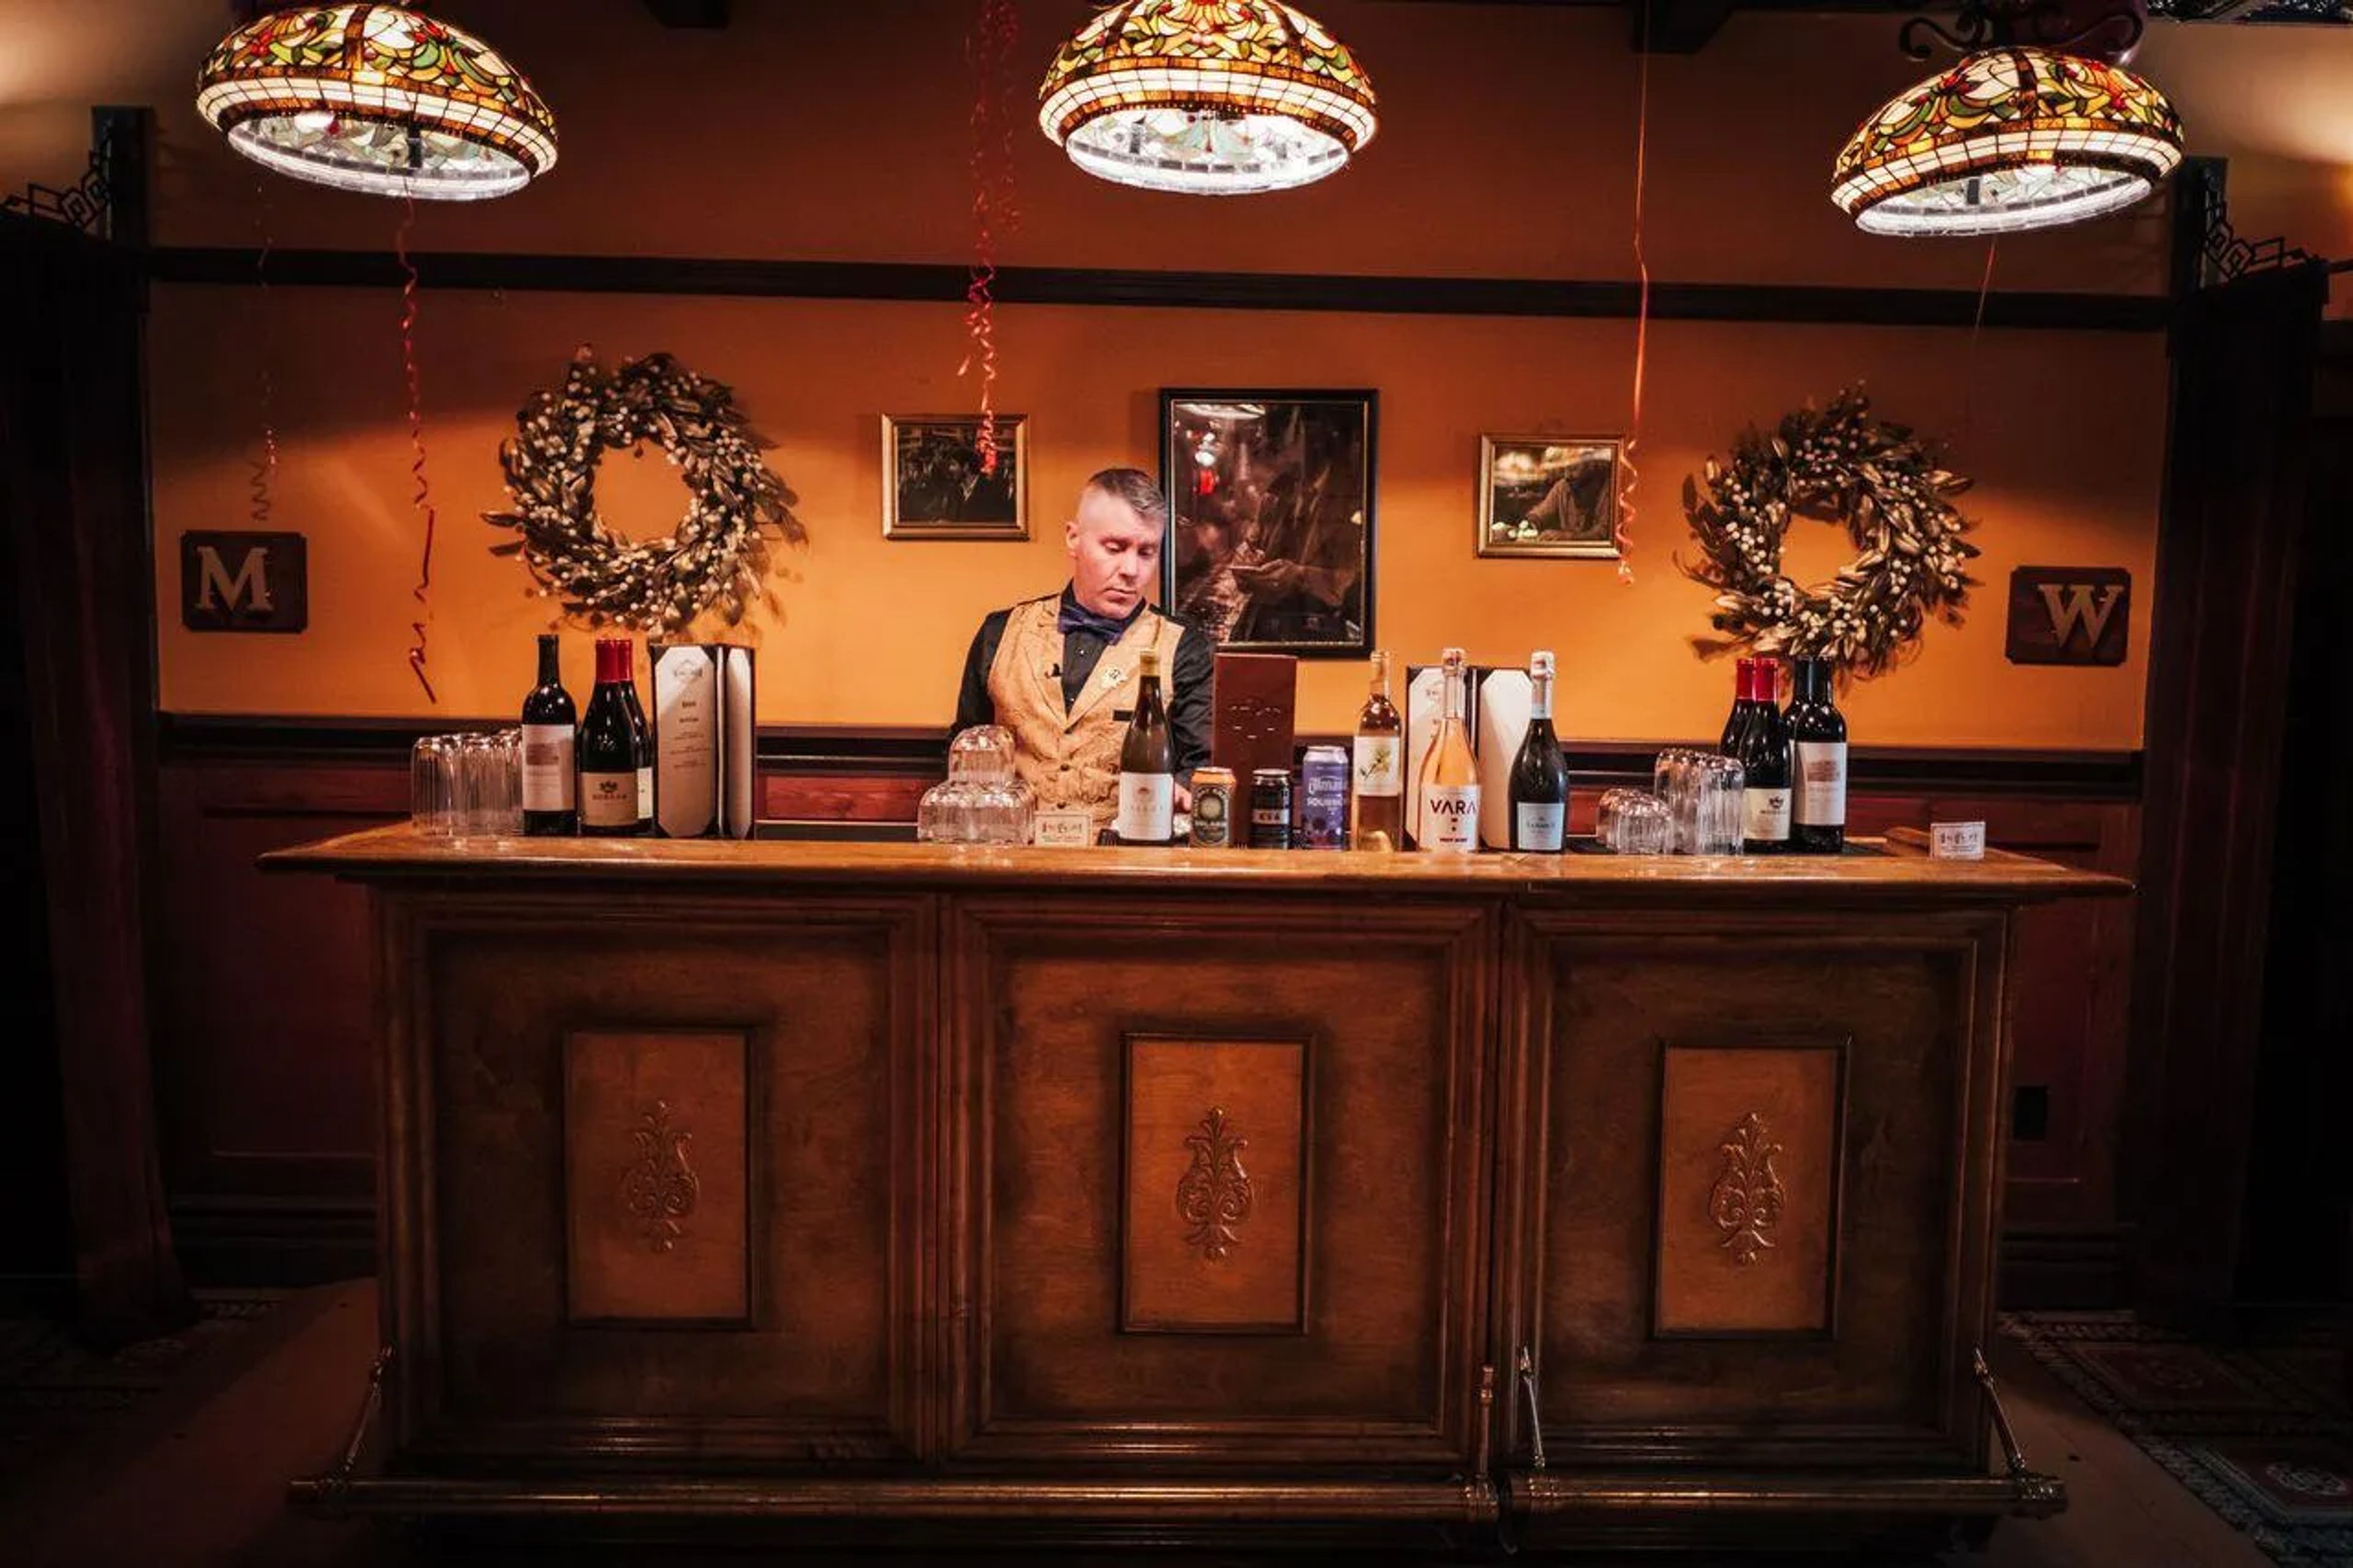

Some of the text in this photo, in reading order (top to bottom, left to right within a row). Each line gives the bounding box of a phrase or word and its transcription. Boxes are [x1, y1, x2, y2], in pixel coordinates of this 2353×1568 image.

[194, 545, 274, 611] M
[2037, 584, 2124, 648] W
[1430, 799, 1476, 815] VARA
